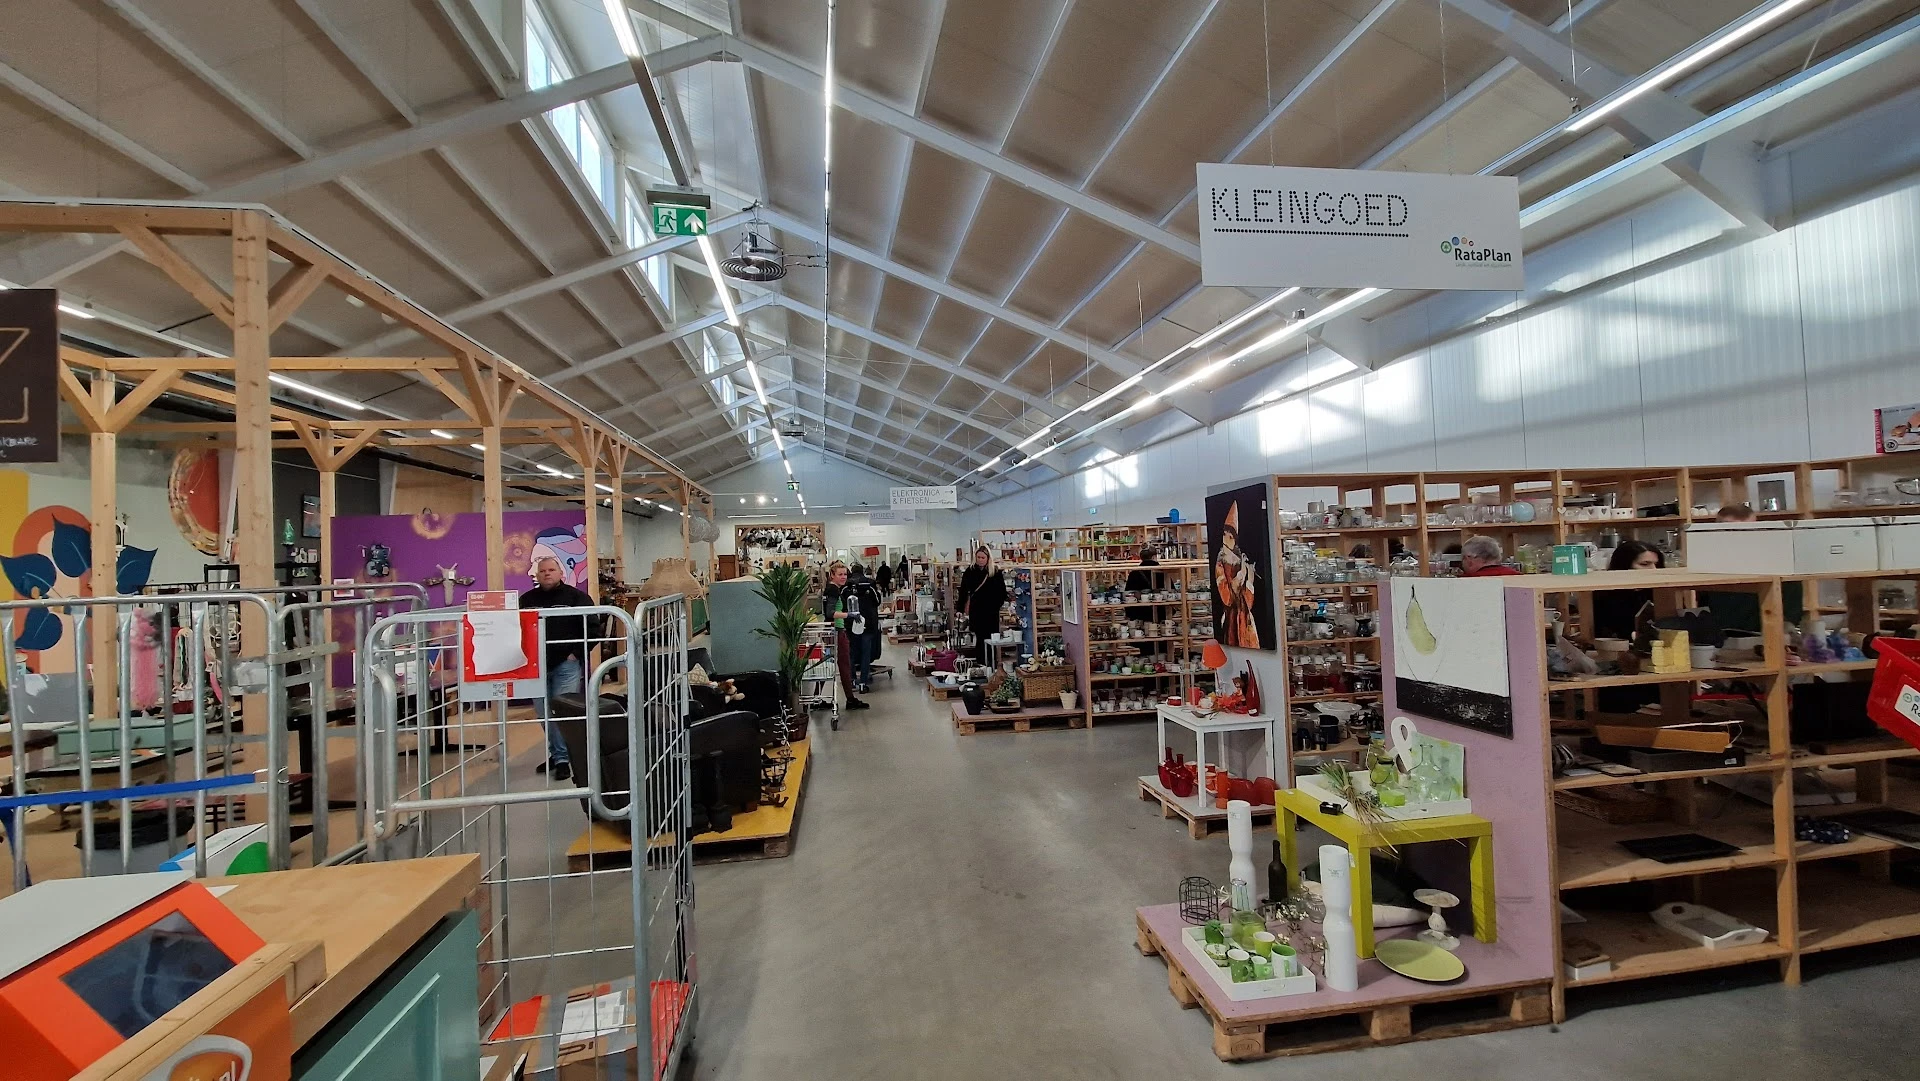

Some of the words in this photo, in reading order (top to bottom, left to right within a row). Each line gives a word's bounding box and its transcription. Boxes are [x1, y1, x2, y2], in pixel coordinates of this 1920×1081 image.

[1211, 187, 1409, 226] KLEINGOED
[1454, 247, 1513, 262] RataPlan
[891, 489, 940, 497] ELEKTRONICA
